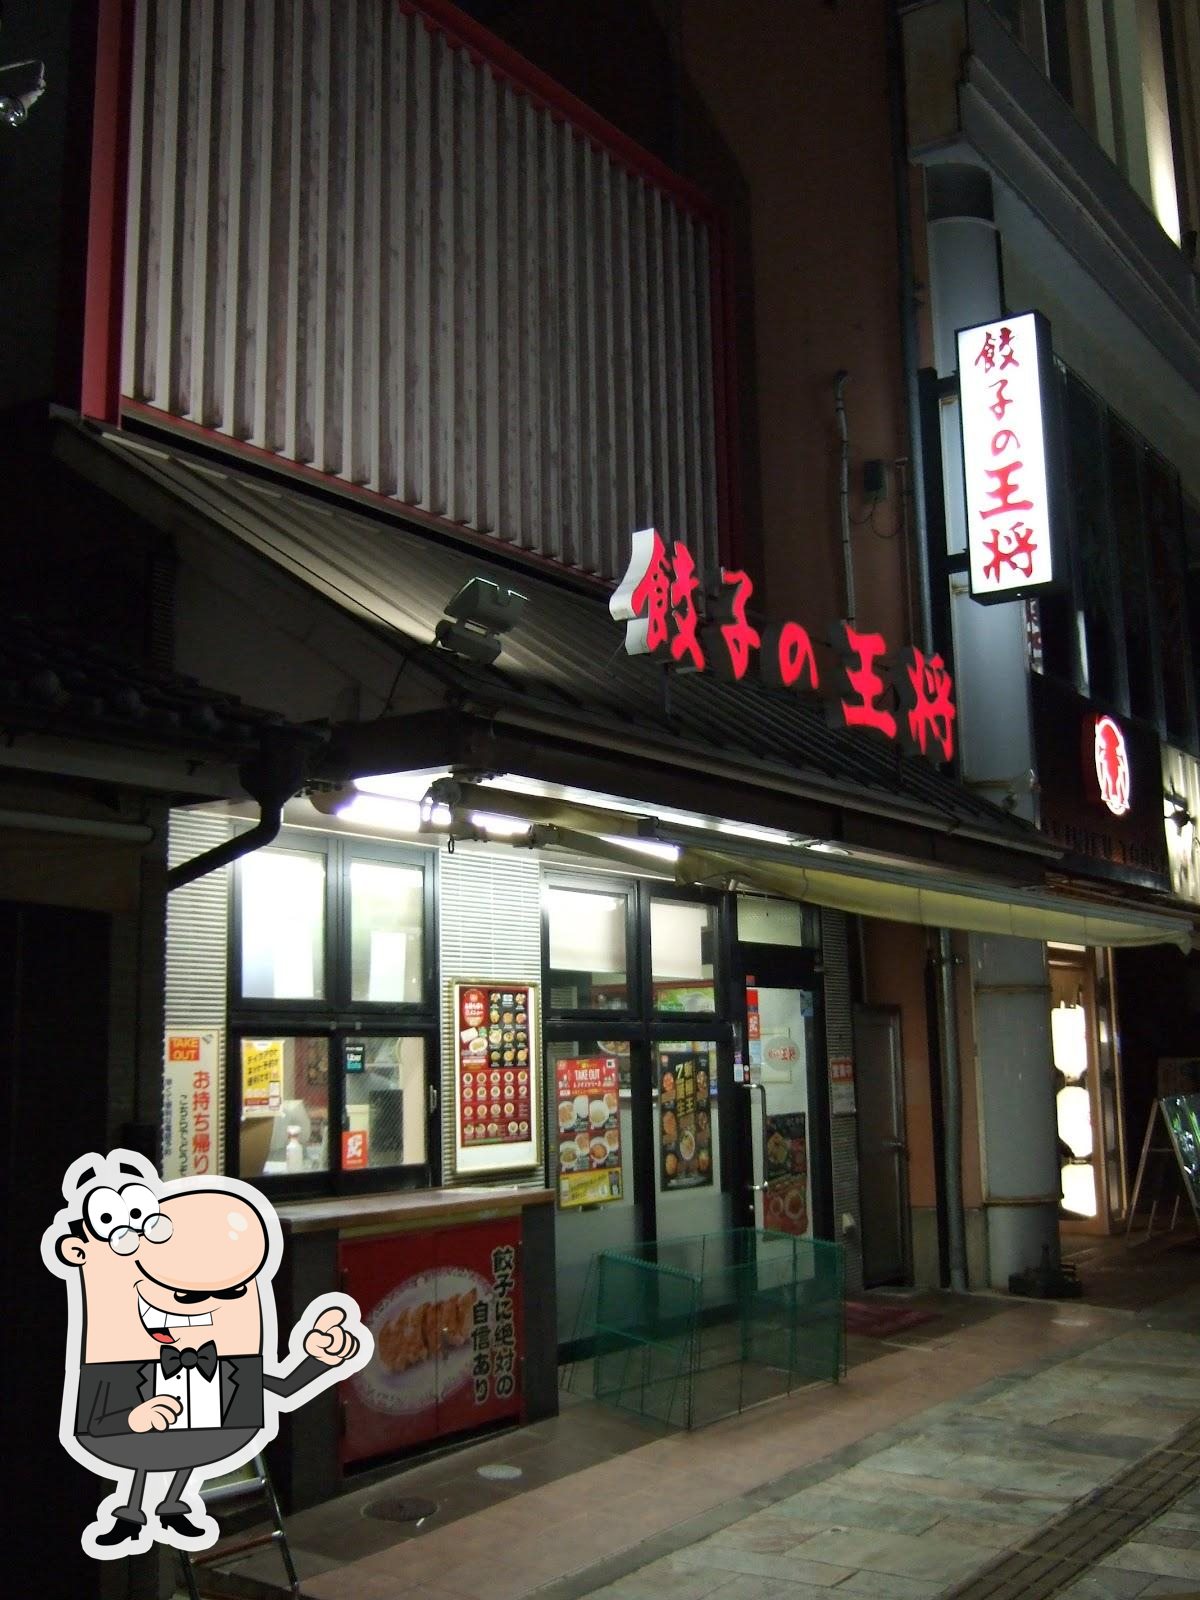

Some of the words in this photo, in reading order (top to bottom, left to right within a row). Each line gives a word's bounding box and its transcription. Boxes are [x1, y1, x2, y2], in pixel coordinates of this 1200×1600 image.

[974, 327, 1038, 584] 餃子の王将
[629, 528, 957, 762] 餃子の王将
[172, 1037, 199, 1049] TAKE
[172, 1050, 197, 1061] OUT
[574, 1069, 588, 1081] TAKE
[589, 1068, 601, 1081] OUT
[192, 1070, 211, 1176] お持ち帰り
[471, 1300, 491, 1402] 自信あり
[492, 1246, 516, 1397] 餃子に絶対の
